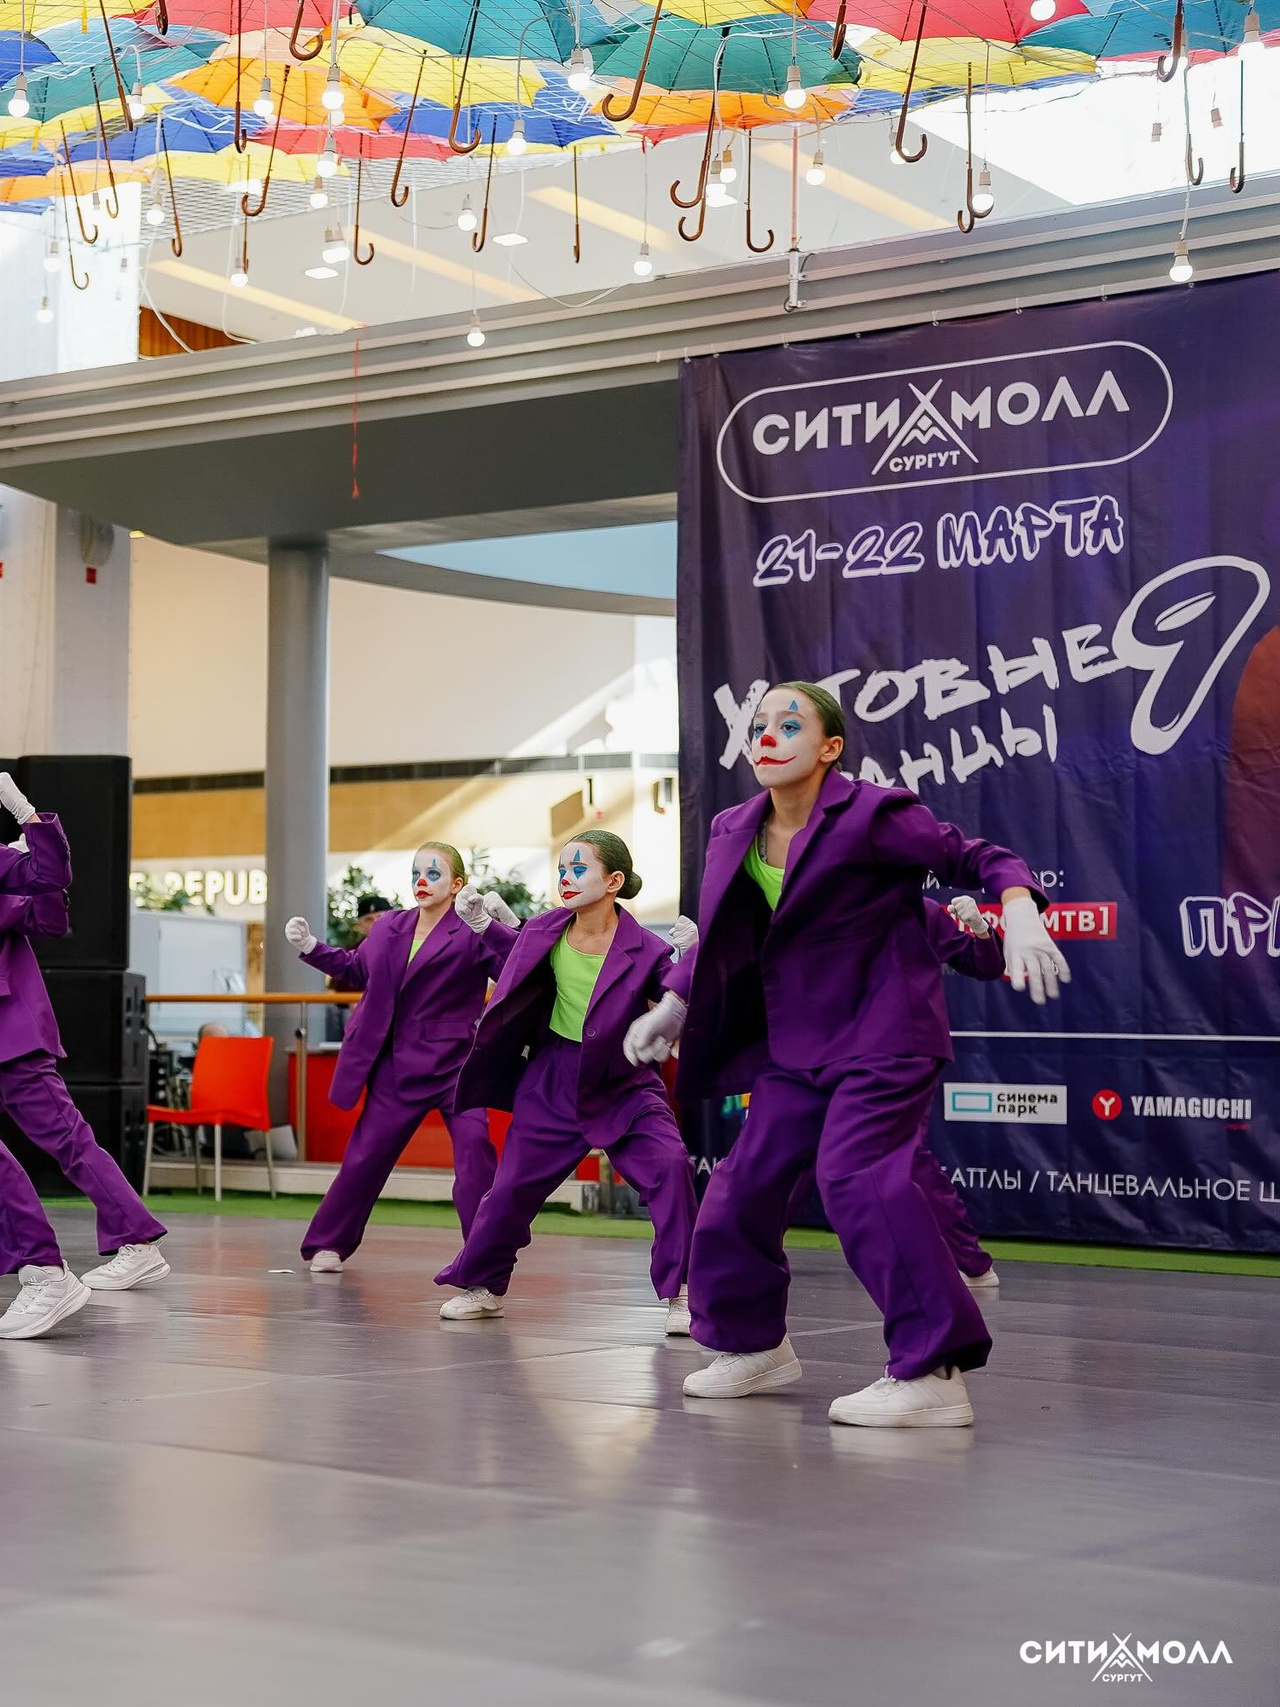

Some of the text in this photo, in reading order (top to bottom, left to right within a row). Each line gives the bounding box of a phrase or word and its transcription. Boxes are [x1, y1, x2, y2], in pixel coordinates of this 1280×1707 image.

[888, 450, 961, 474] СУРГУТ
[753, 495, 1124, 588] 21-22 МАРТА
[713, 624, 1120, 771] ХТОВЫЕ
[840, 705, 1058, 796] АНЦЫ
[164, 868, 267, 906] REPUB
[997, 1092, 1059, 1105] синема
[997, 1103, 1038, 1118] парк
[1131, 1095, 1252, 1120] YAMAGUCHI
[941, 1166, 1022, 1191] АТТЛЫ
[1046, 1170, 1252, 1202] ТАНЦЕВАЛЬНОЕ
